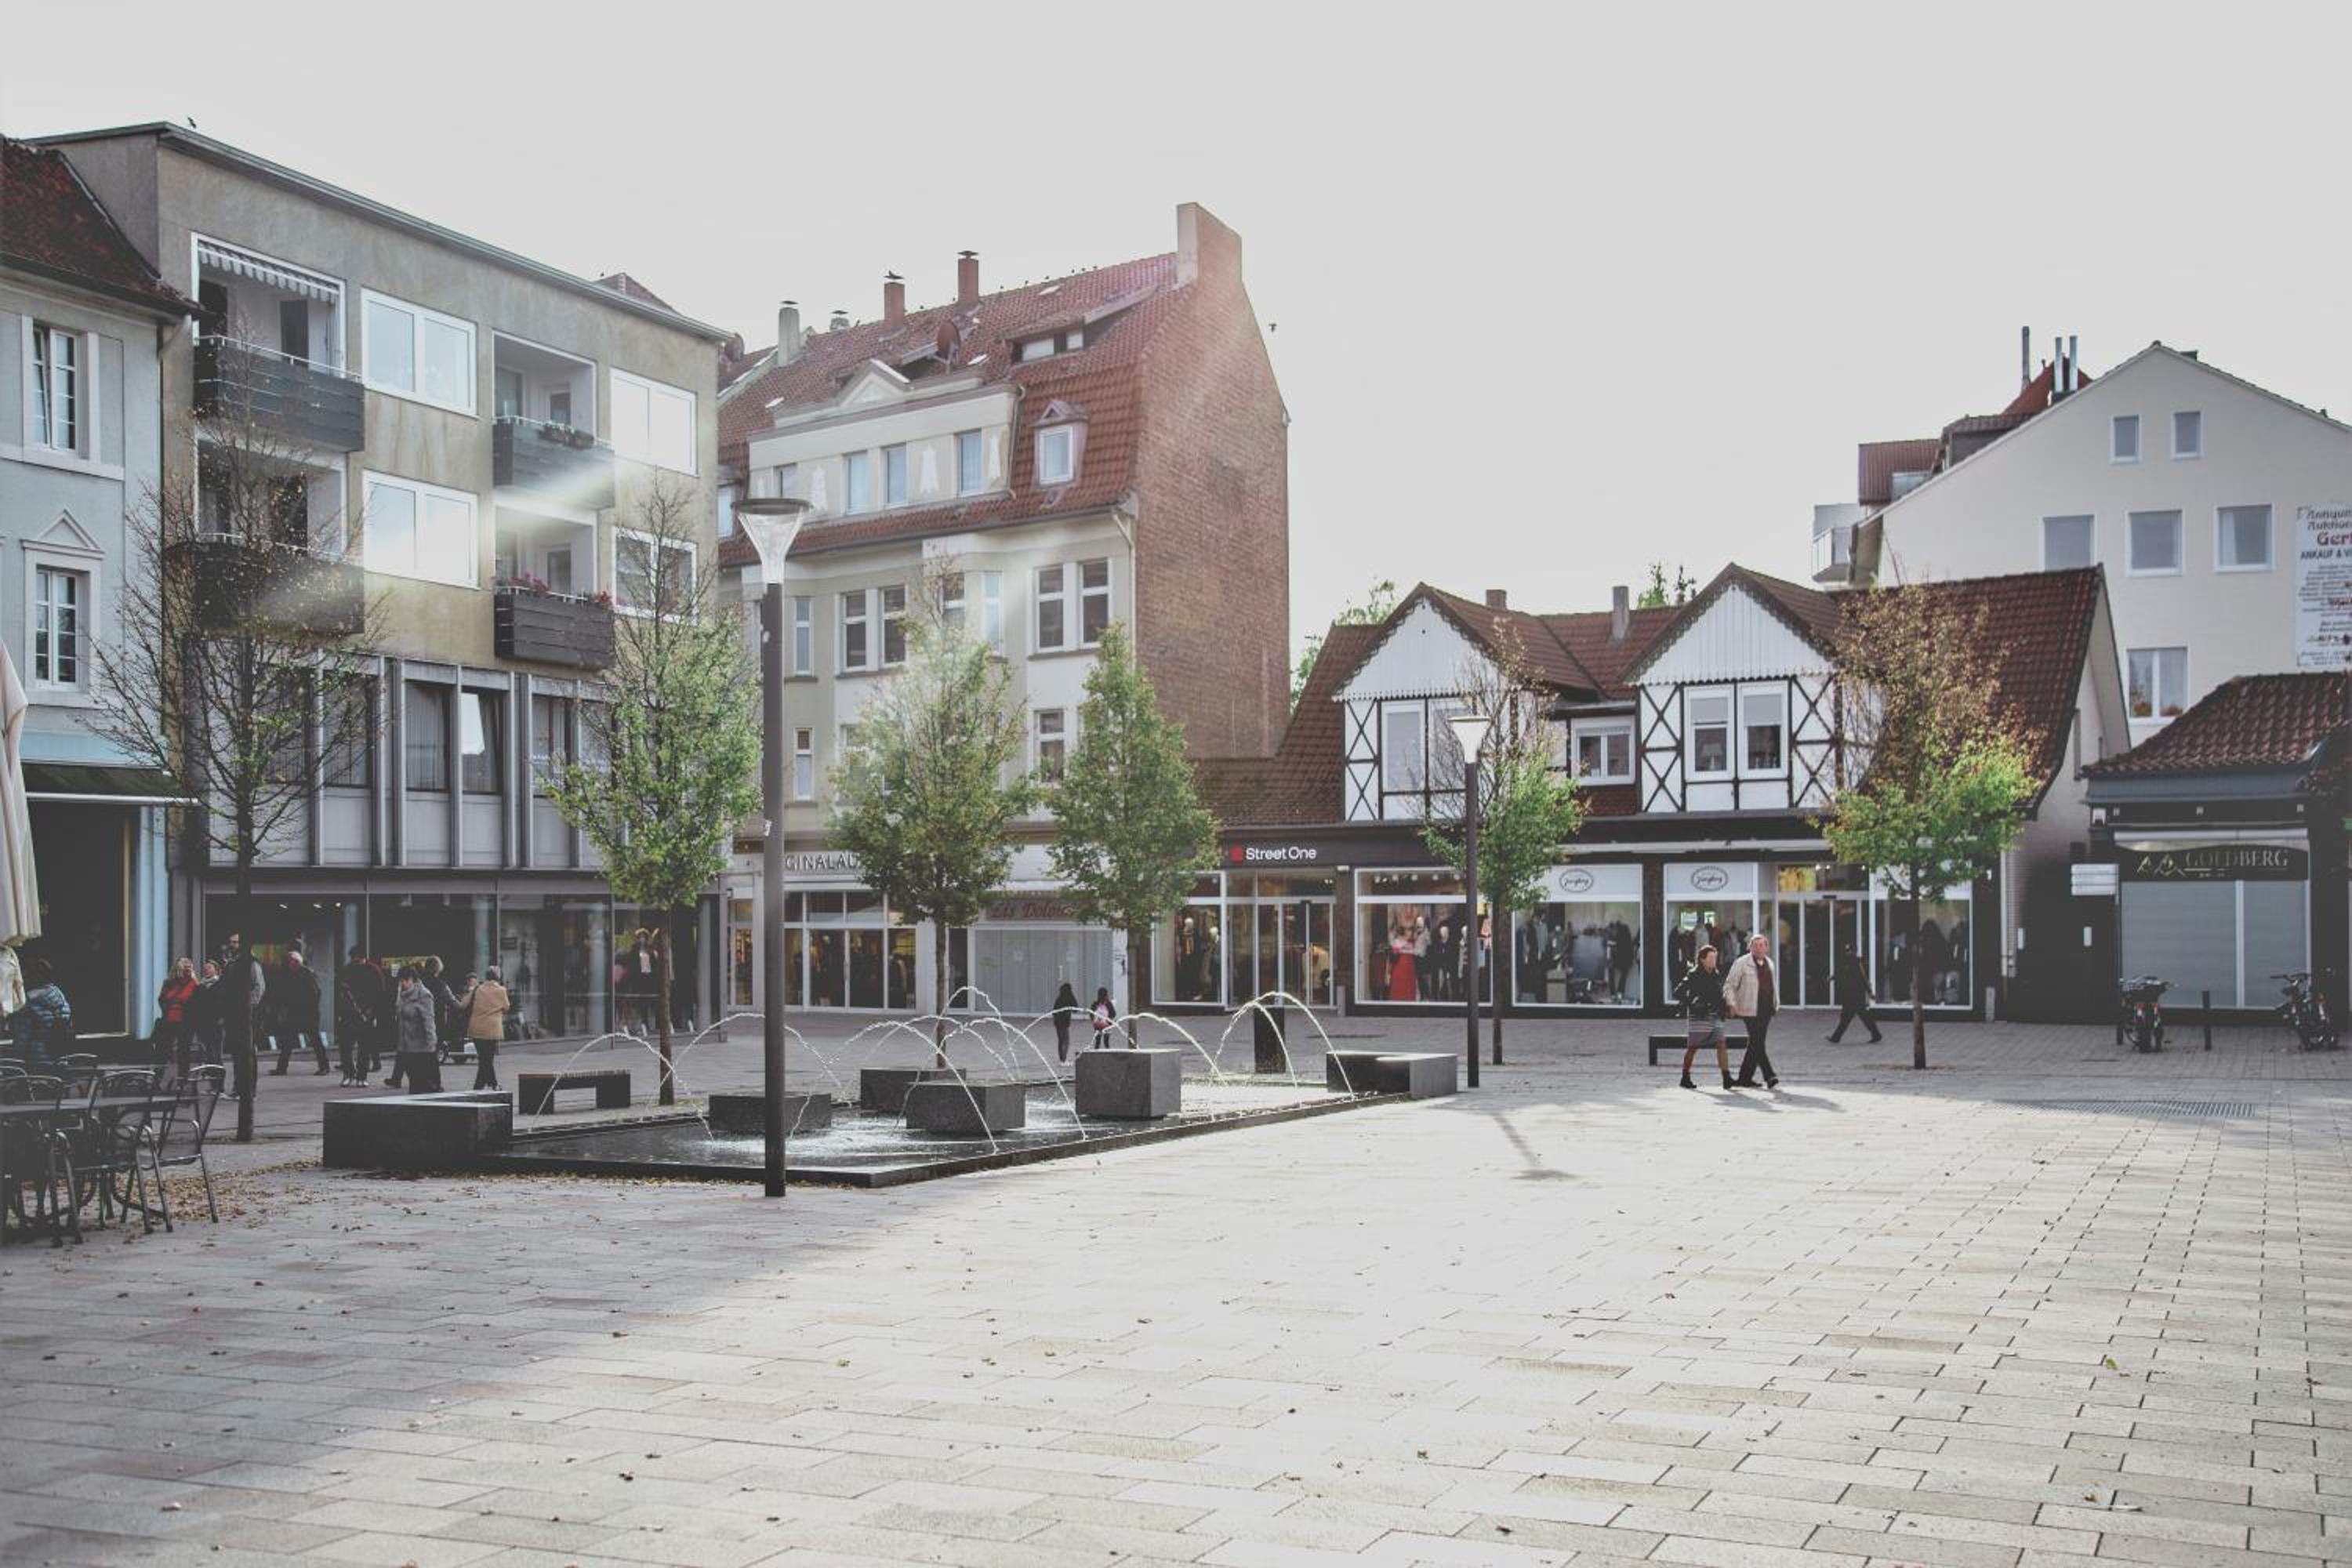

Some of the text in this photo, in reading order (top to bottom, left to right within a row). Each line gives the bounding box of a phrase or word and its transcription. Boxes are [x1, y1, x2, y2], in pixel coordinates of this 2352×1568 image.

[786, 852, 858, 871] GINALAU
[1246, 846, 1318, 861] Street One
